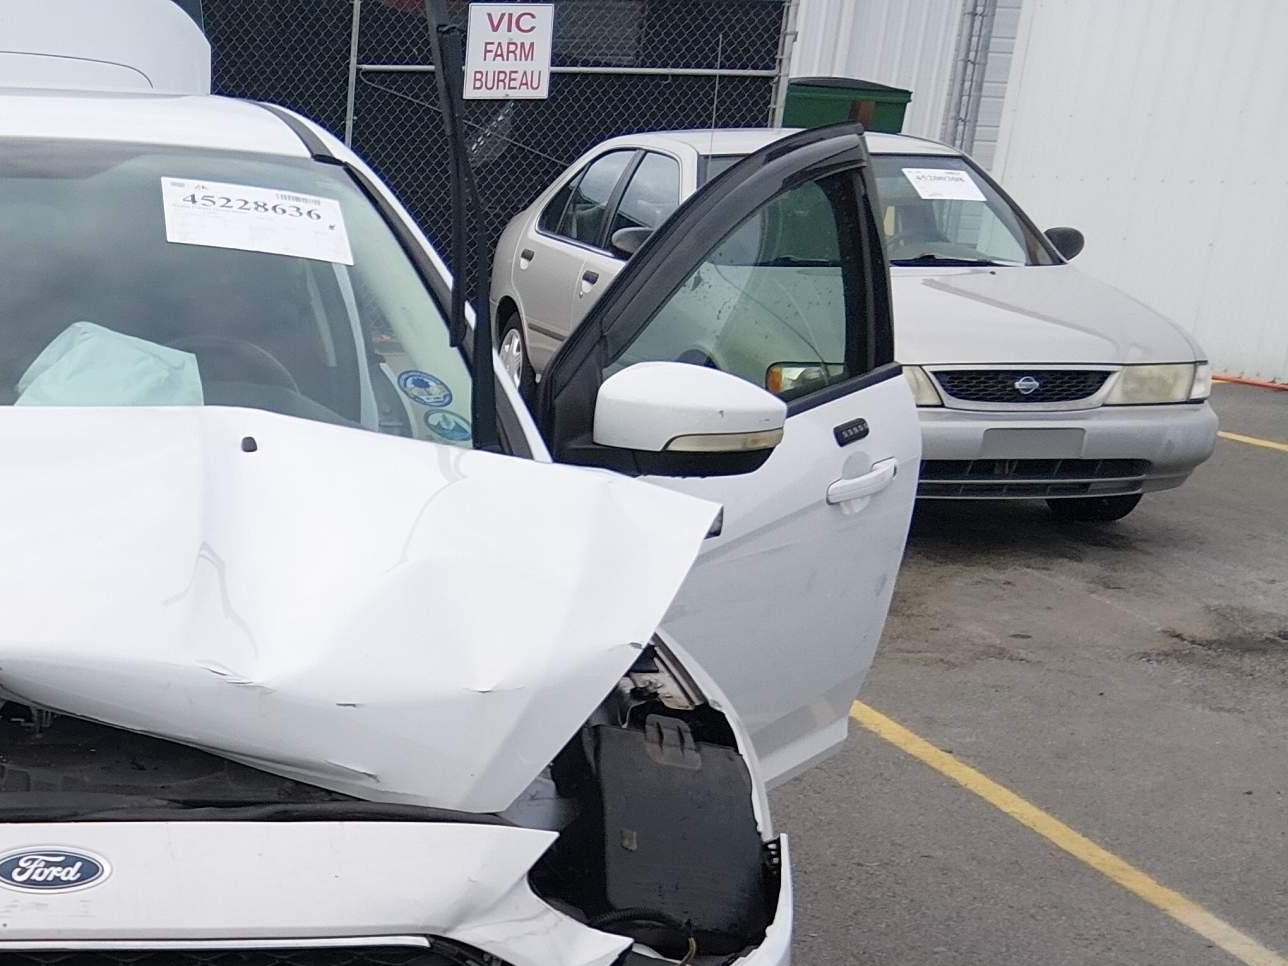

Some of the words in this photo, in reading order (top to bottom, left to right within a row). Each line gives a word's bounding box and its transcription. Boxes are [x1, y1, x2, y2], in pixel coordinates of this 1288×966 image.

[486, 12, 537, 33] VIC
[483, 41, 535, 62] FARM
[472, 70, 542, 91] BUREAU
[182, 193, 322, 221] 45228636
[12, 855, 83, 882] Ford
